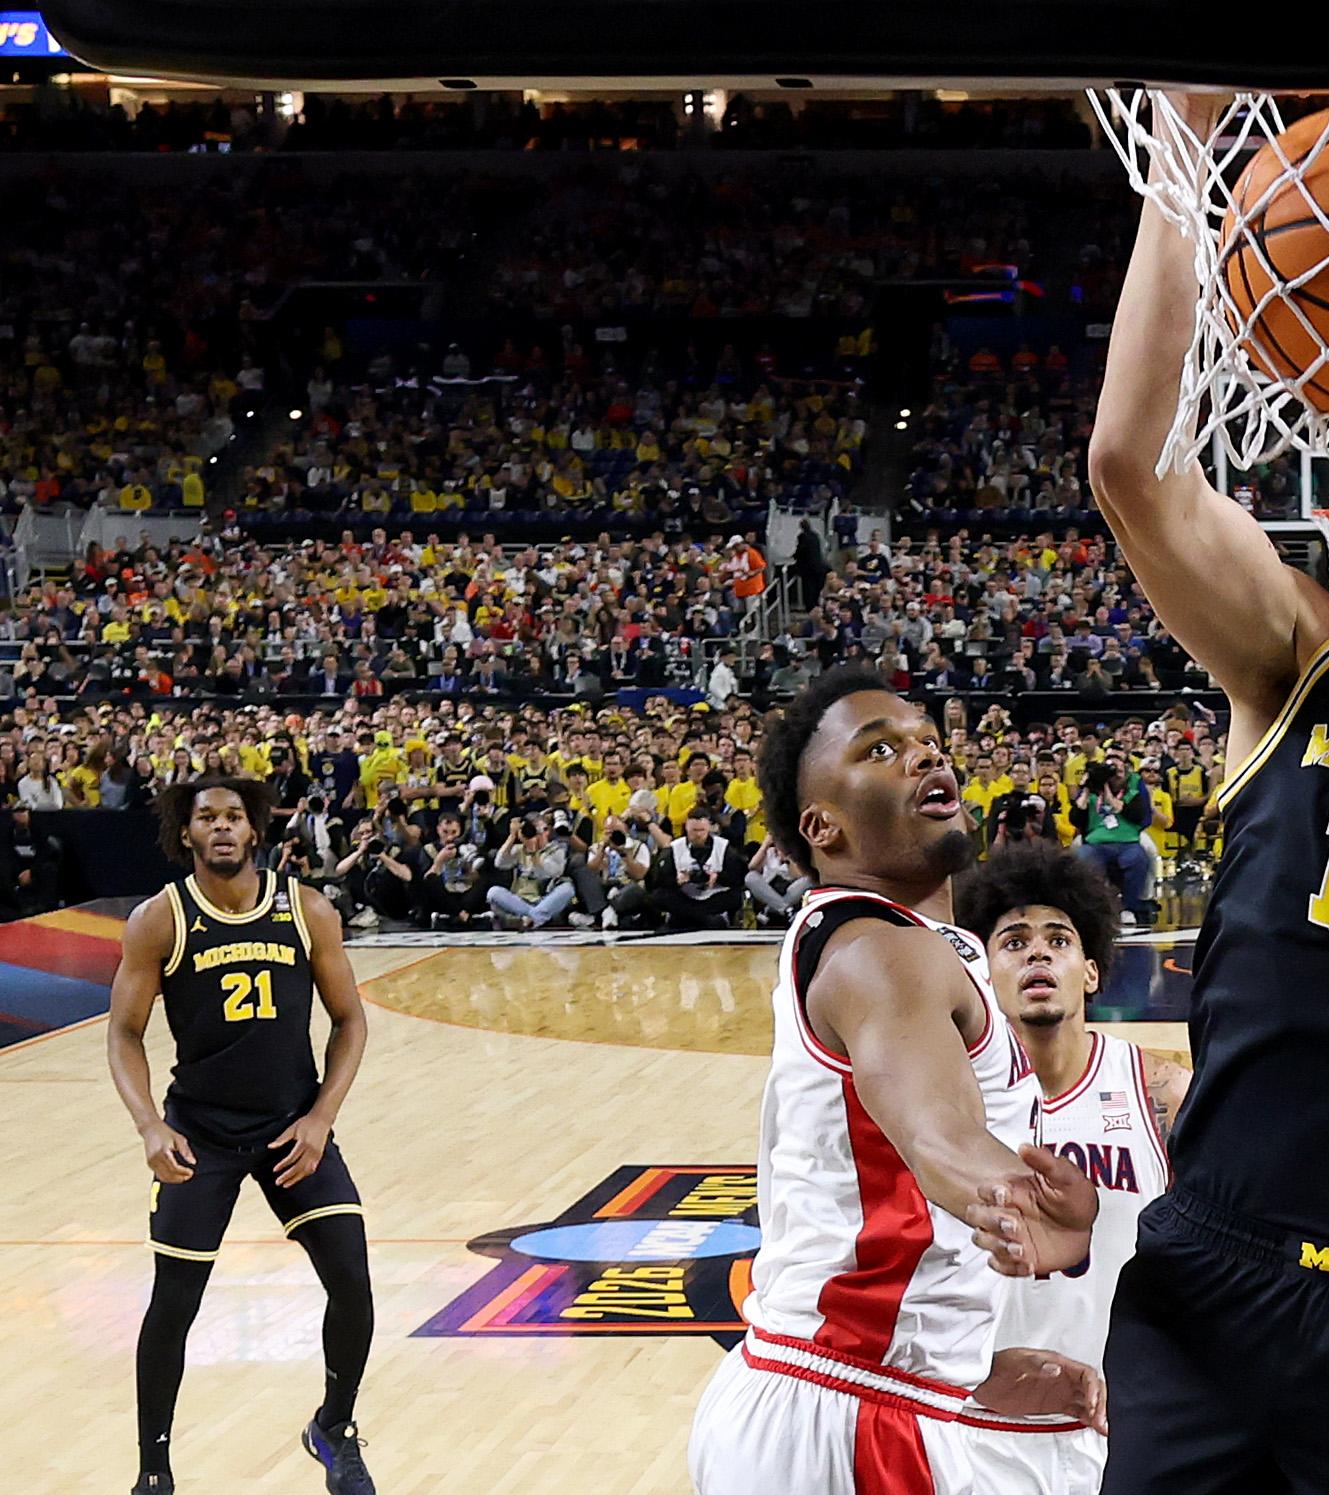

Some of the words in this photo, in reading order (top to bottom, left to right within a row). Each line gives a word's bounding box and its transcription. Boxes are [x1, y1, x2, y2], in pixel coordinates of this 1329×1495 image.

[193, 942, 296, 973] MICHIGAN
[220, 970, 277, 1022] 21
[628, 1221, 721, 1258] NCAA
[559, 1266, 695, 1320] 2026
